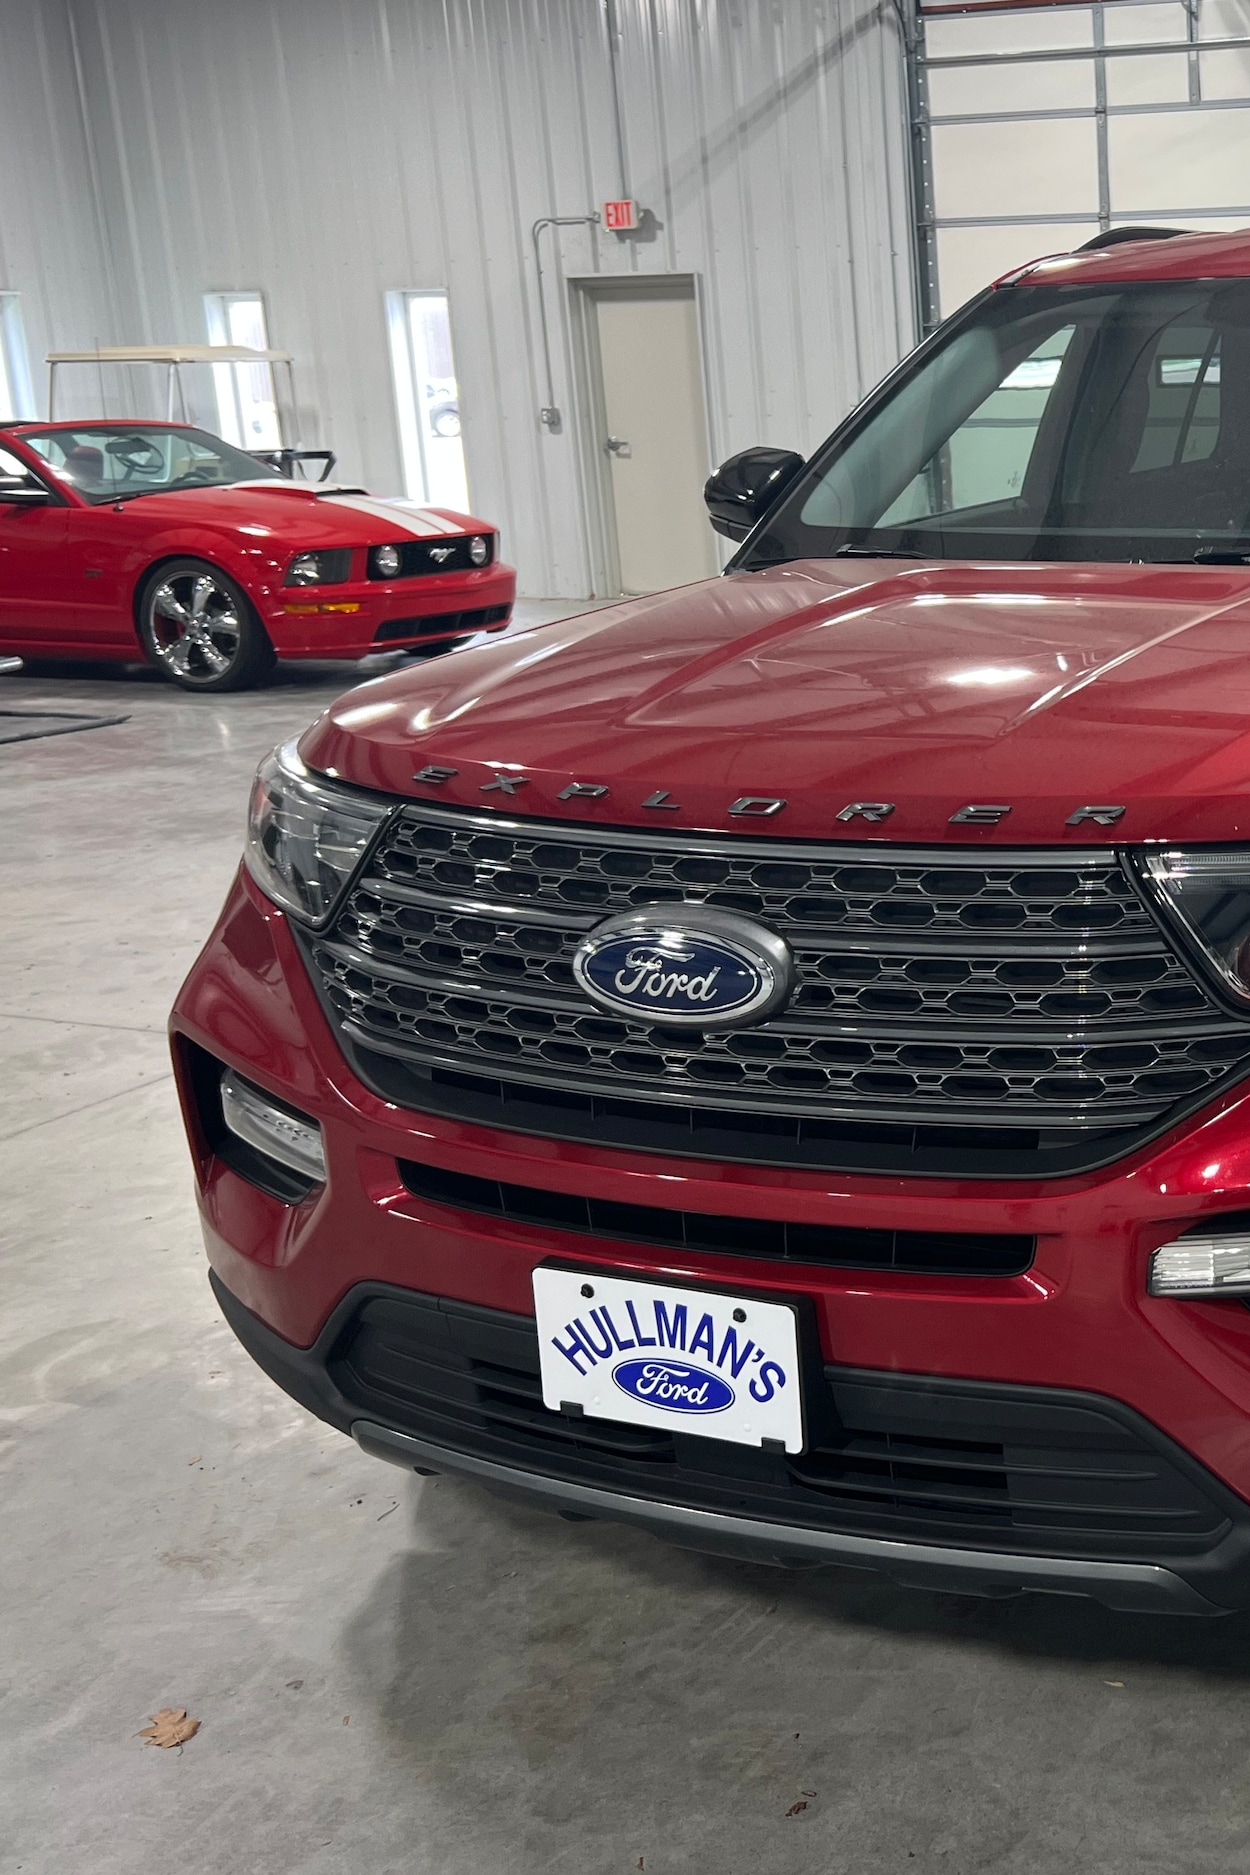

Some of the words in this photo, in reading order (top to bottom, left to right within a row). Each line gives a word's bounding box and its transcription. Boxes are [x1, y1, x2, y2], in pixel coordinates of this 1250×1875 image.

[605, 201, 632, 228] EXIT
[411, 764, 1126, 826] EXPLORER
[614, 946, 722, 1002] Ford
[551, 1300, 786, 1403] HULLMAN'S
[636, 1364, 710, 1405] Ford
